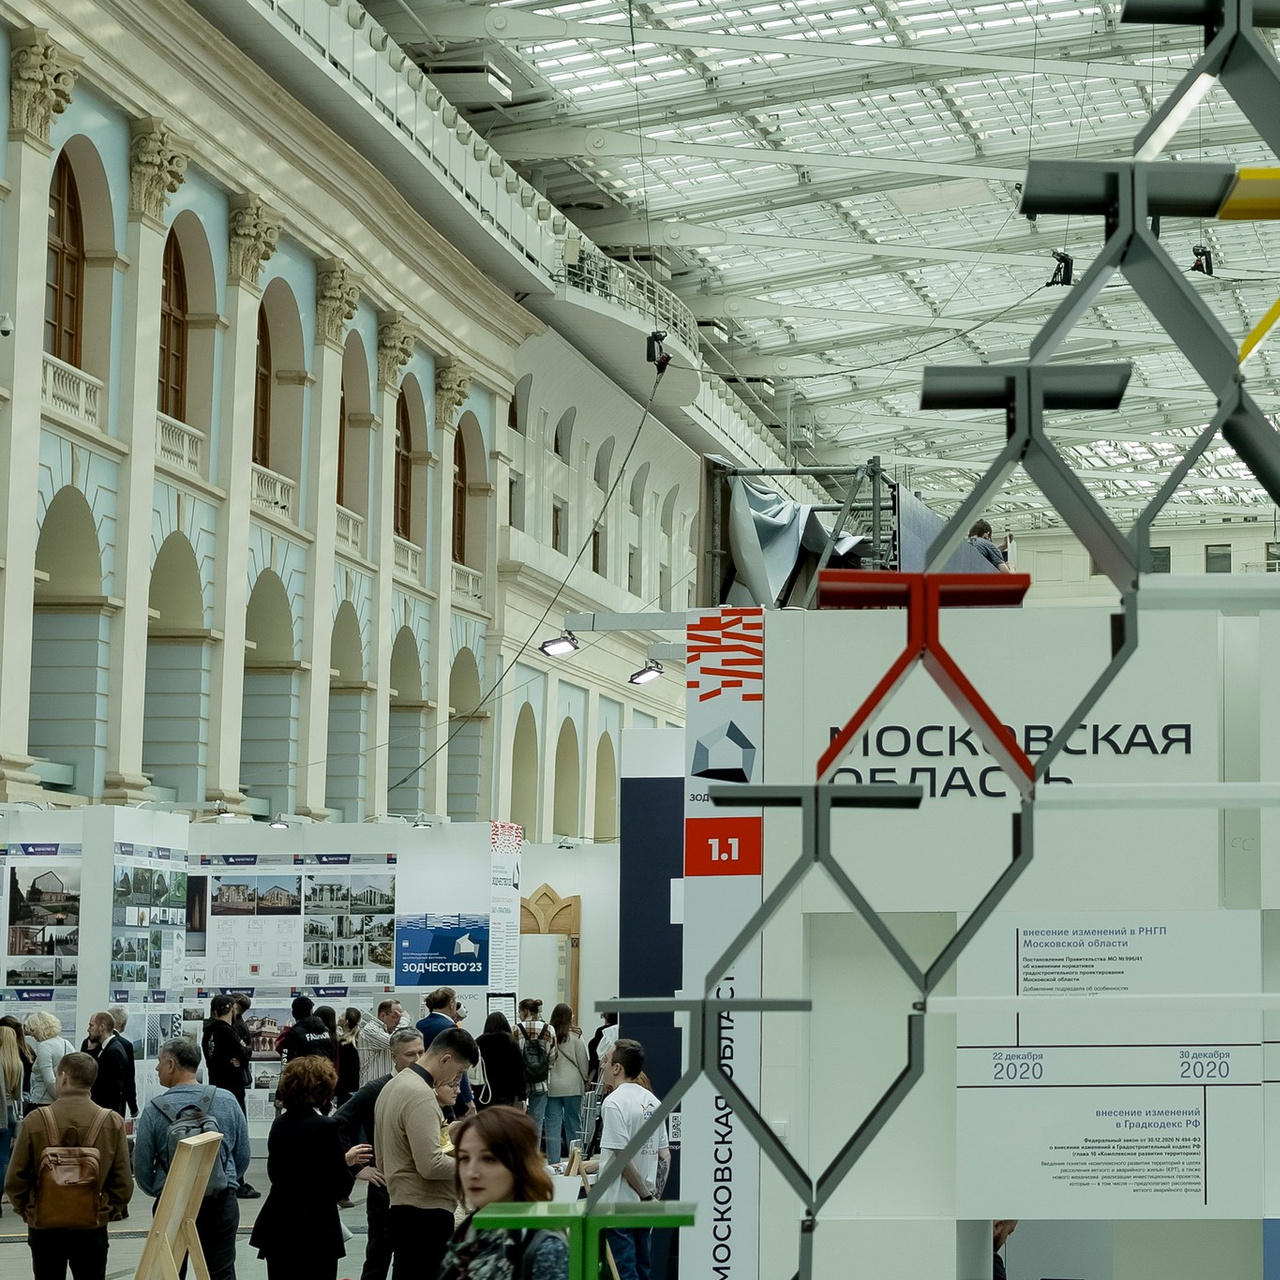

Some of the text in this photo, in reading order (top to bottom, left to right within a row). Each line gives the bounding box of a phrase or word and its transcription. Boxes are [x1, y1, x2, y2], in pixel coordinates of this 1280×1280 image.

[708, 837, 739, 861] 1.1
[1072, 926, 1127, 936] изменений
[1138, 926, 1167, 936] РНГП
[1023, 938, 1128, 948] Московской области
[992, 1051, 1044, 1063] 22 декабря
[1179, 1049, 1230, 1062] 30 декабря
[994, 1062, 1043, 1080] 2020
[1180, 1061, 1229, 1078] 2020
[1145, 1107, 1200, 1117] изменений
[1115, 1118, 1201, 1131] в Градкодекс РФ
